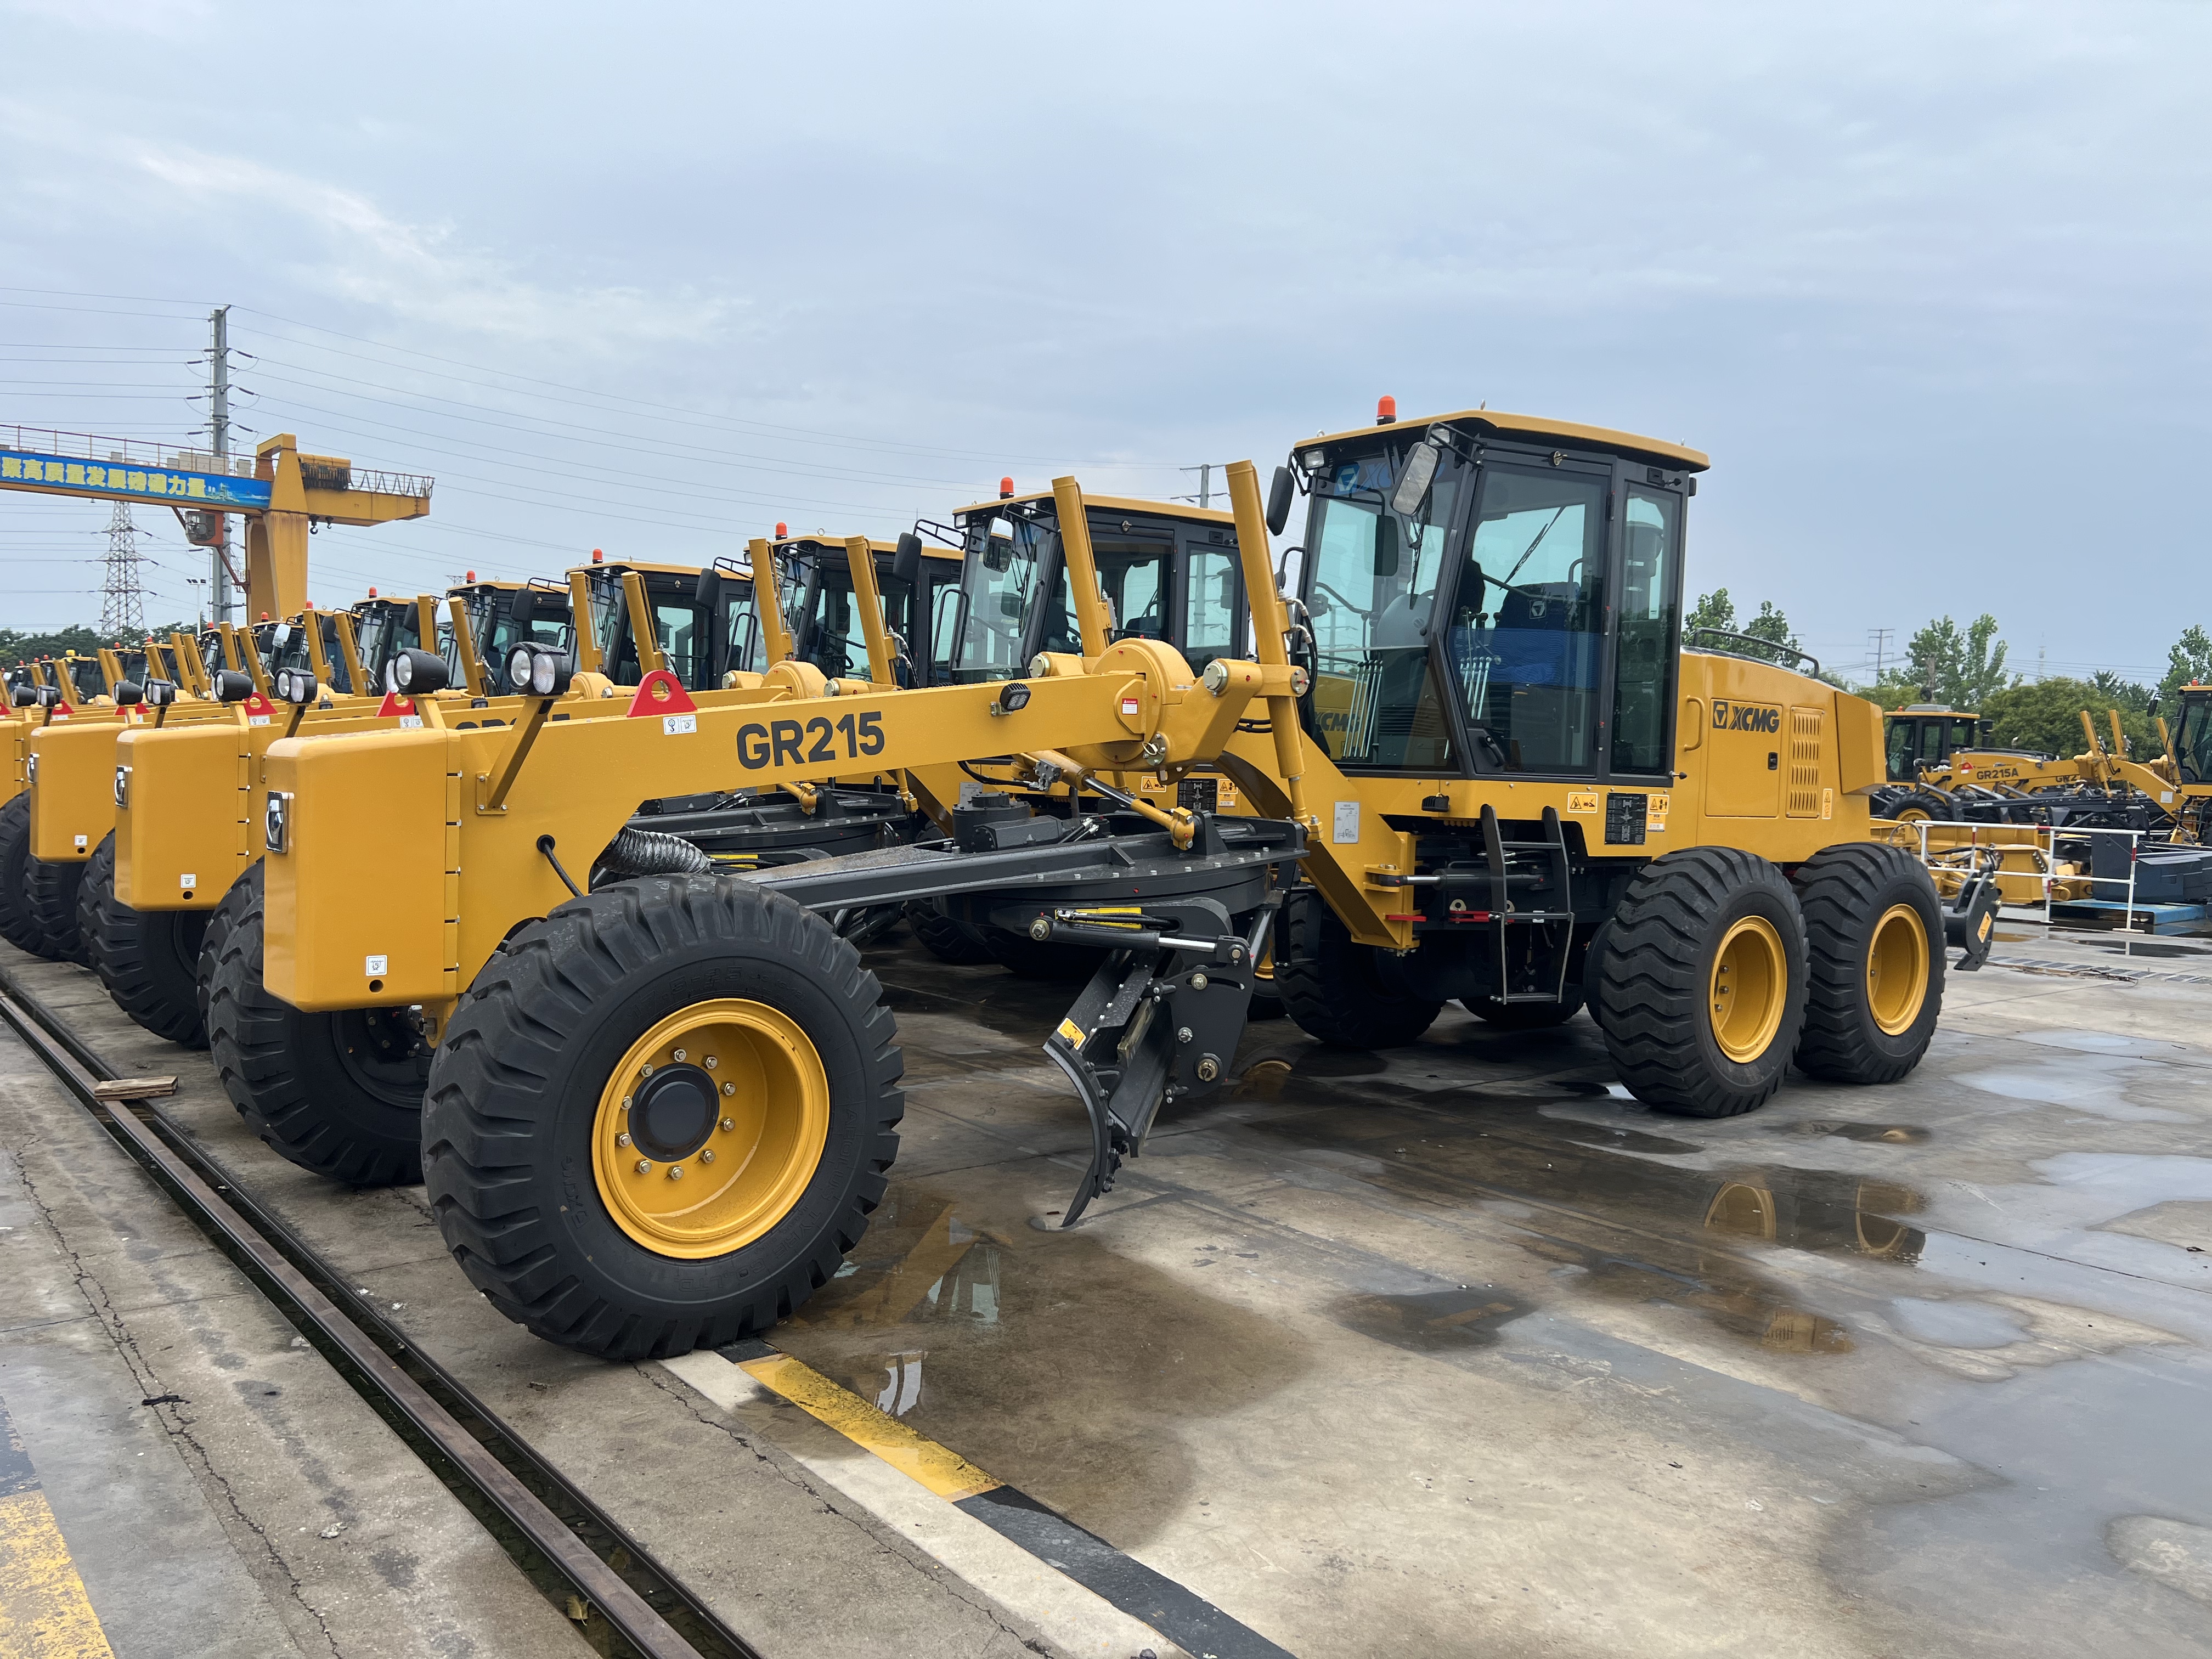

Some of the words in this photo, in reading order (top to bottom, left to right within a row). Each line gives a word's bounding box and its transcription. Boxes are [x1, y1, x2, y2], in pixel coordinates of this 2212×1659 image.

[1728, 706, 1779, 733] XCMG
[736, 710, 885, 769] GR215
[1977, 768, 2019, 780] GR215A
